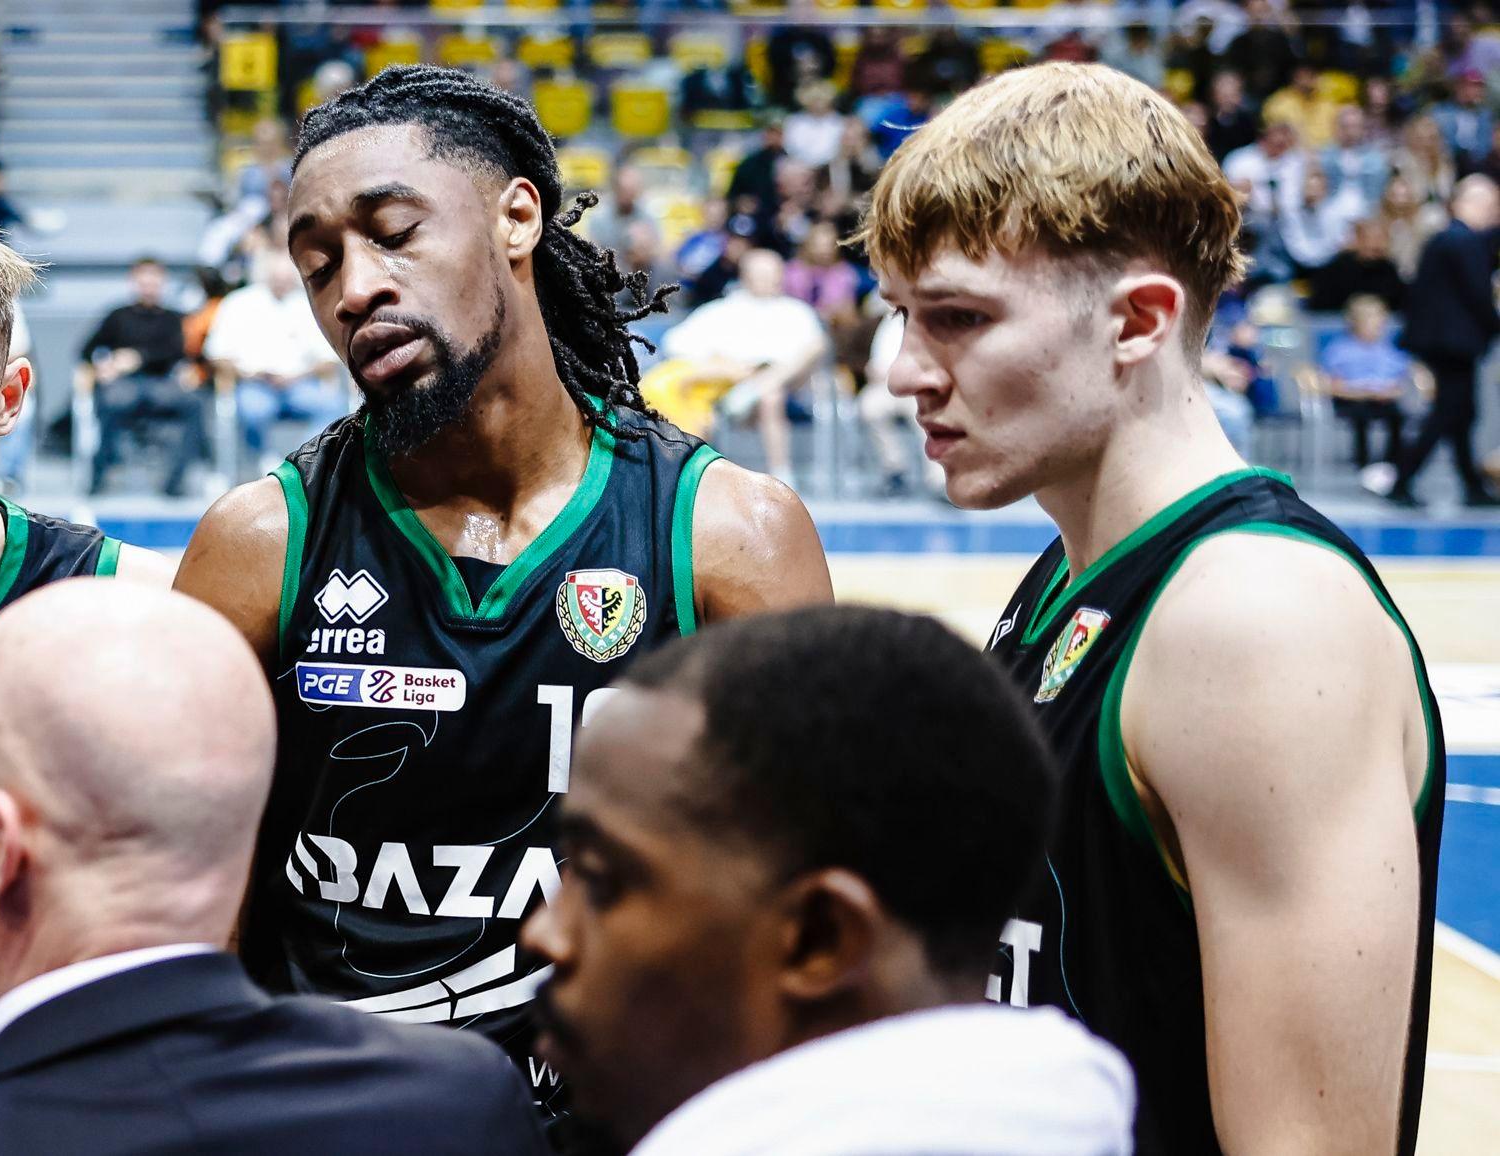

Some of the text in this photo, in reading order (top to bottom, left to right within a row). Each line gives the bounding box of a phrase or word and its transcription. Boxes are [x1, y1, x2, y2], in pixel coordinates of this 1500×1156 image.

[304, 673, 353, 694] PGE
[404, 674, 456, 688] Basket
[404, 689, 435, 705] Liga
